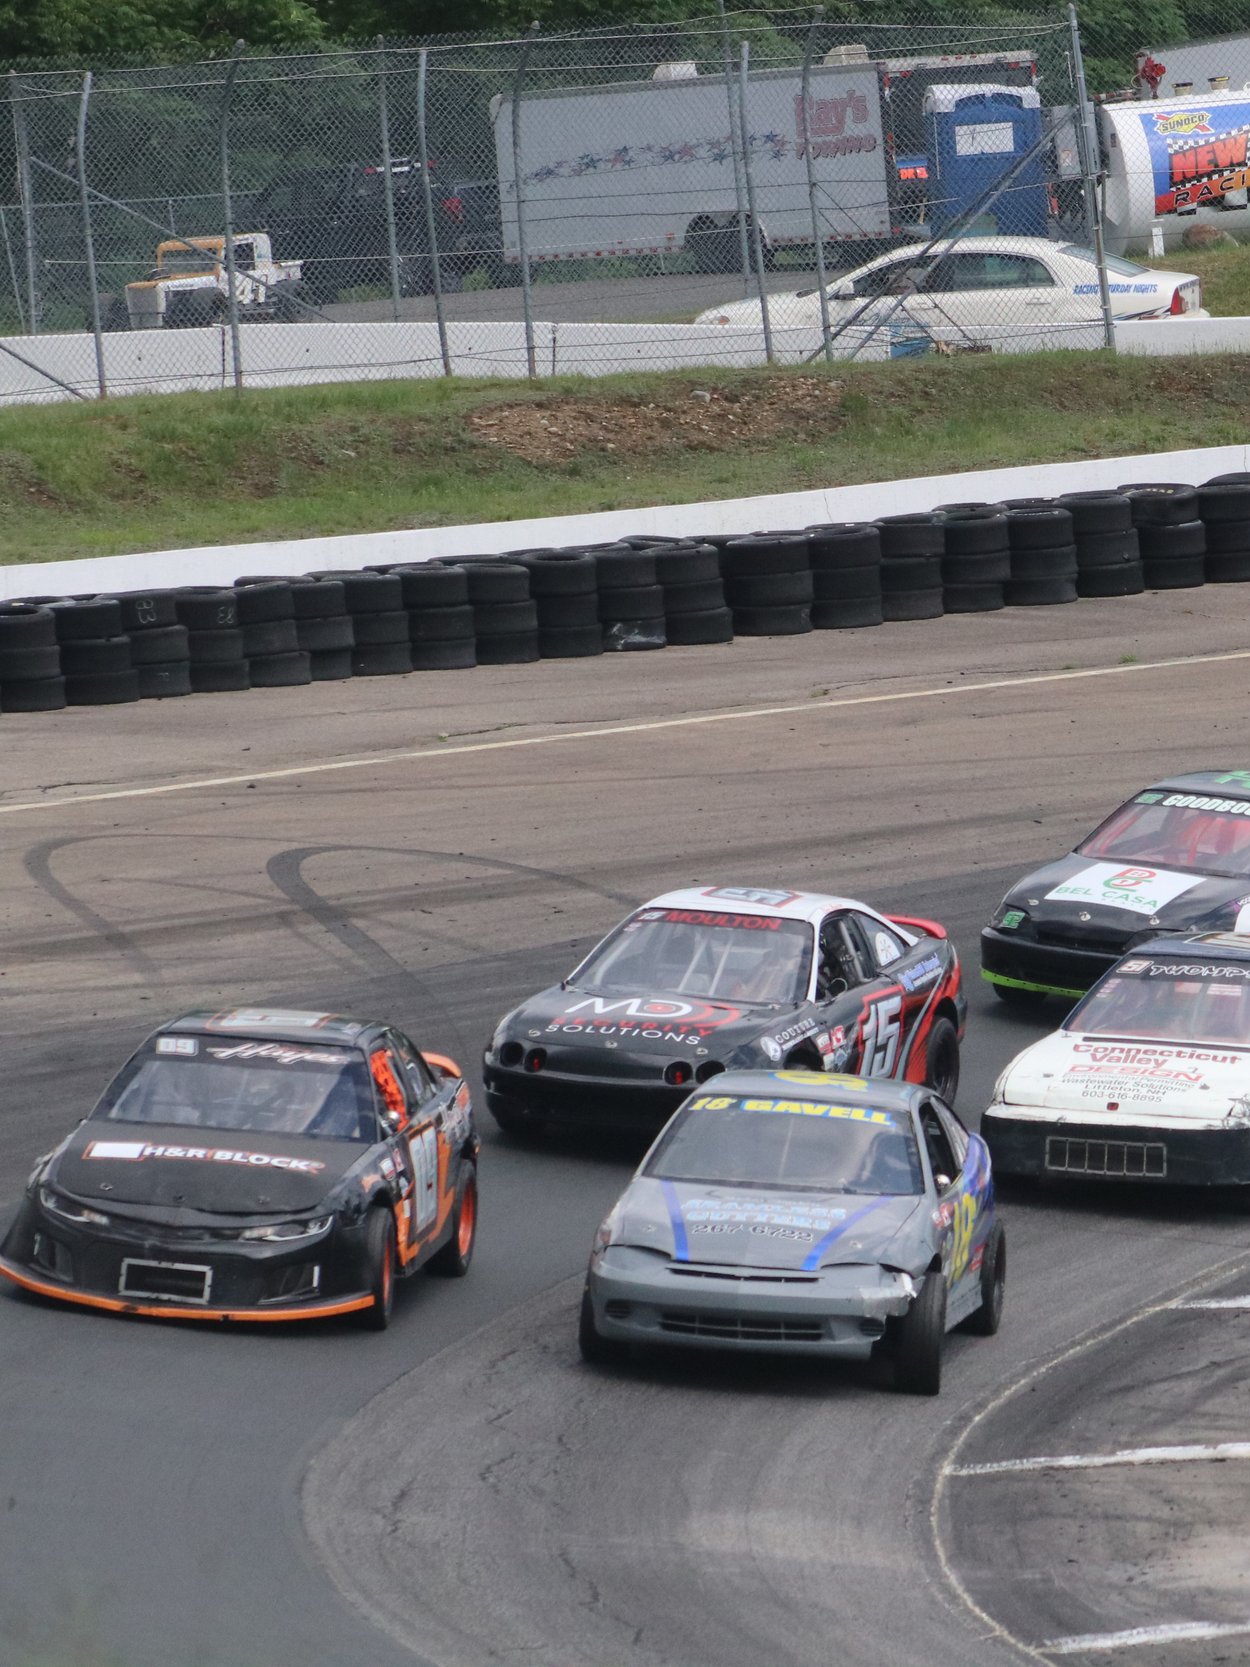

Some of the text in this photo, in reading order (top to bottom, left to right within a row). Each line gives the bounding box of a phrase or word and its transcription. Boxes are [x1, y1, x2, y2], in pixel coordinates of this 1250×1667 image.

[1160, 114, 1205, 131] SUNOCO
[1171, 133, 1248, 182] NEW
[1133, 284, 1158, 294] NIGHTS
[1055, 886, 1094, 896] BEL
[1101, 890, 1158, 909] CASA
[664, 911, 782, 930] MOULTON
[545, 1024, 701, 1045] SOLUTIONS
[860, 997, 901, 1079] 15
[1073, 1044, 1242, 1064] Connecticut
[1090, 1053, 1168, 1069] Valley
[1069, 1065, 1205, 1082] DESIGN
[1062, 1077, 1187, 1093] Wastewater Solutions
[1085, 1084, 1168, 1096] Littleton, NH
[1081, 1090, 1163, 1103] 603-616-8895
[743, 1099, 893, 1126] GAVELL
[143, 1146, 313, 1171] H&R BLOCK
[750, 1225, 813, 1242] 6722
